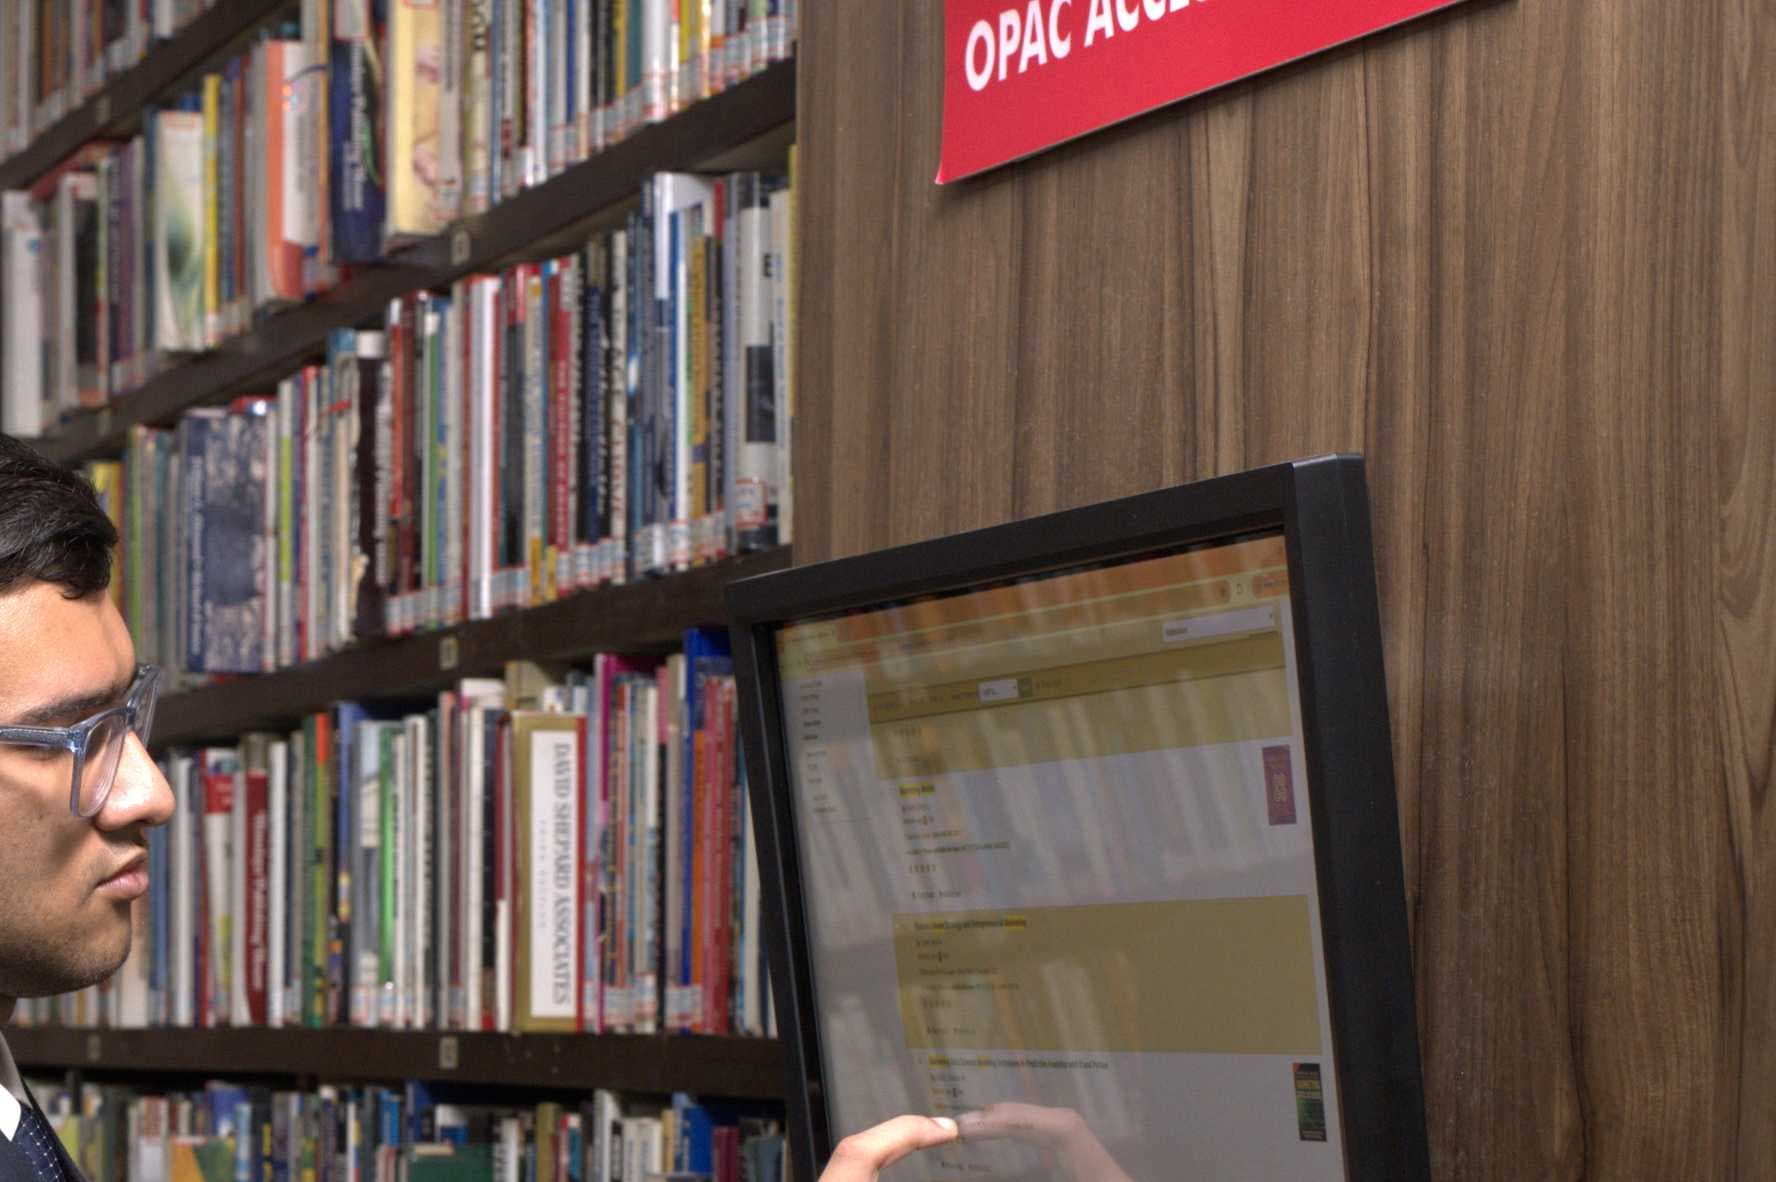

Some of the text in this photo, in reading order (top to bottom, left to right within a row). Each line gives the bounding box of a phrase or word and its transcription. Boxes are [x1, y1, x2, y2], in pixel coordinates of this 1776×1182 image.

[965, 0, 1071, 91] OPAC
[554, 743, 571, 1005] DAVID SHEPARD ASSOCIATES
